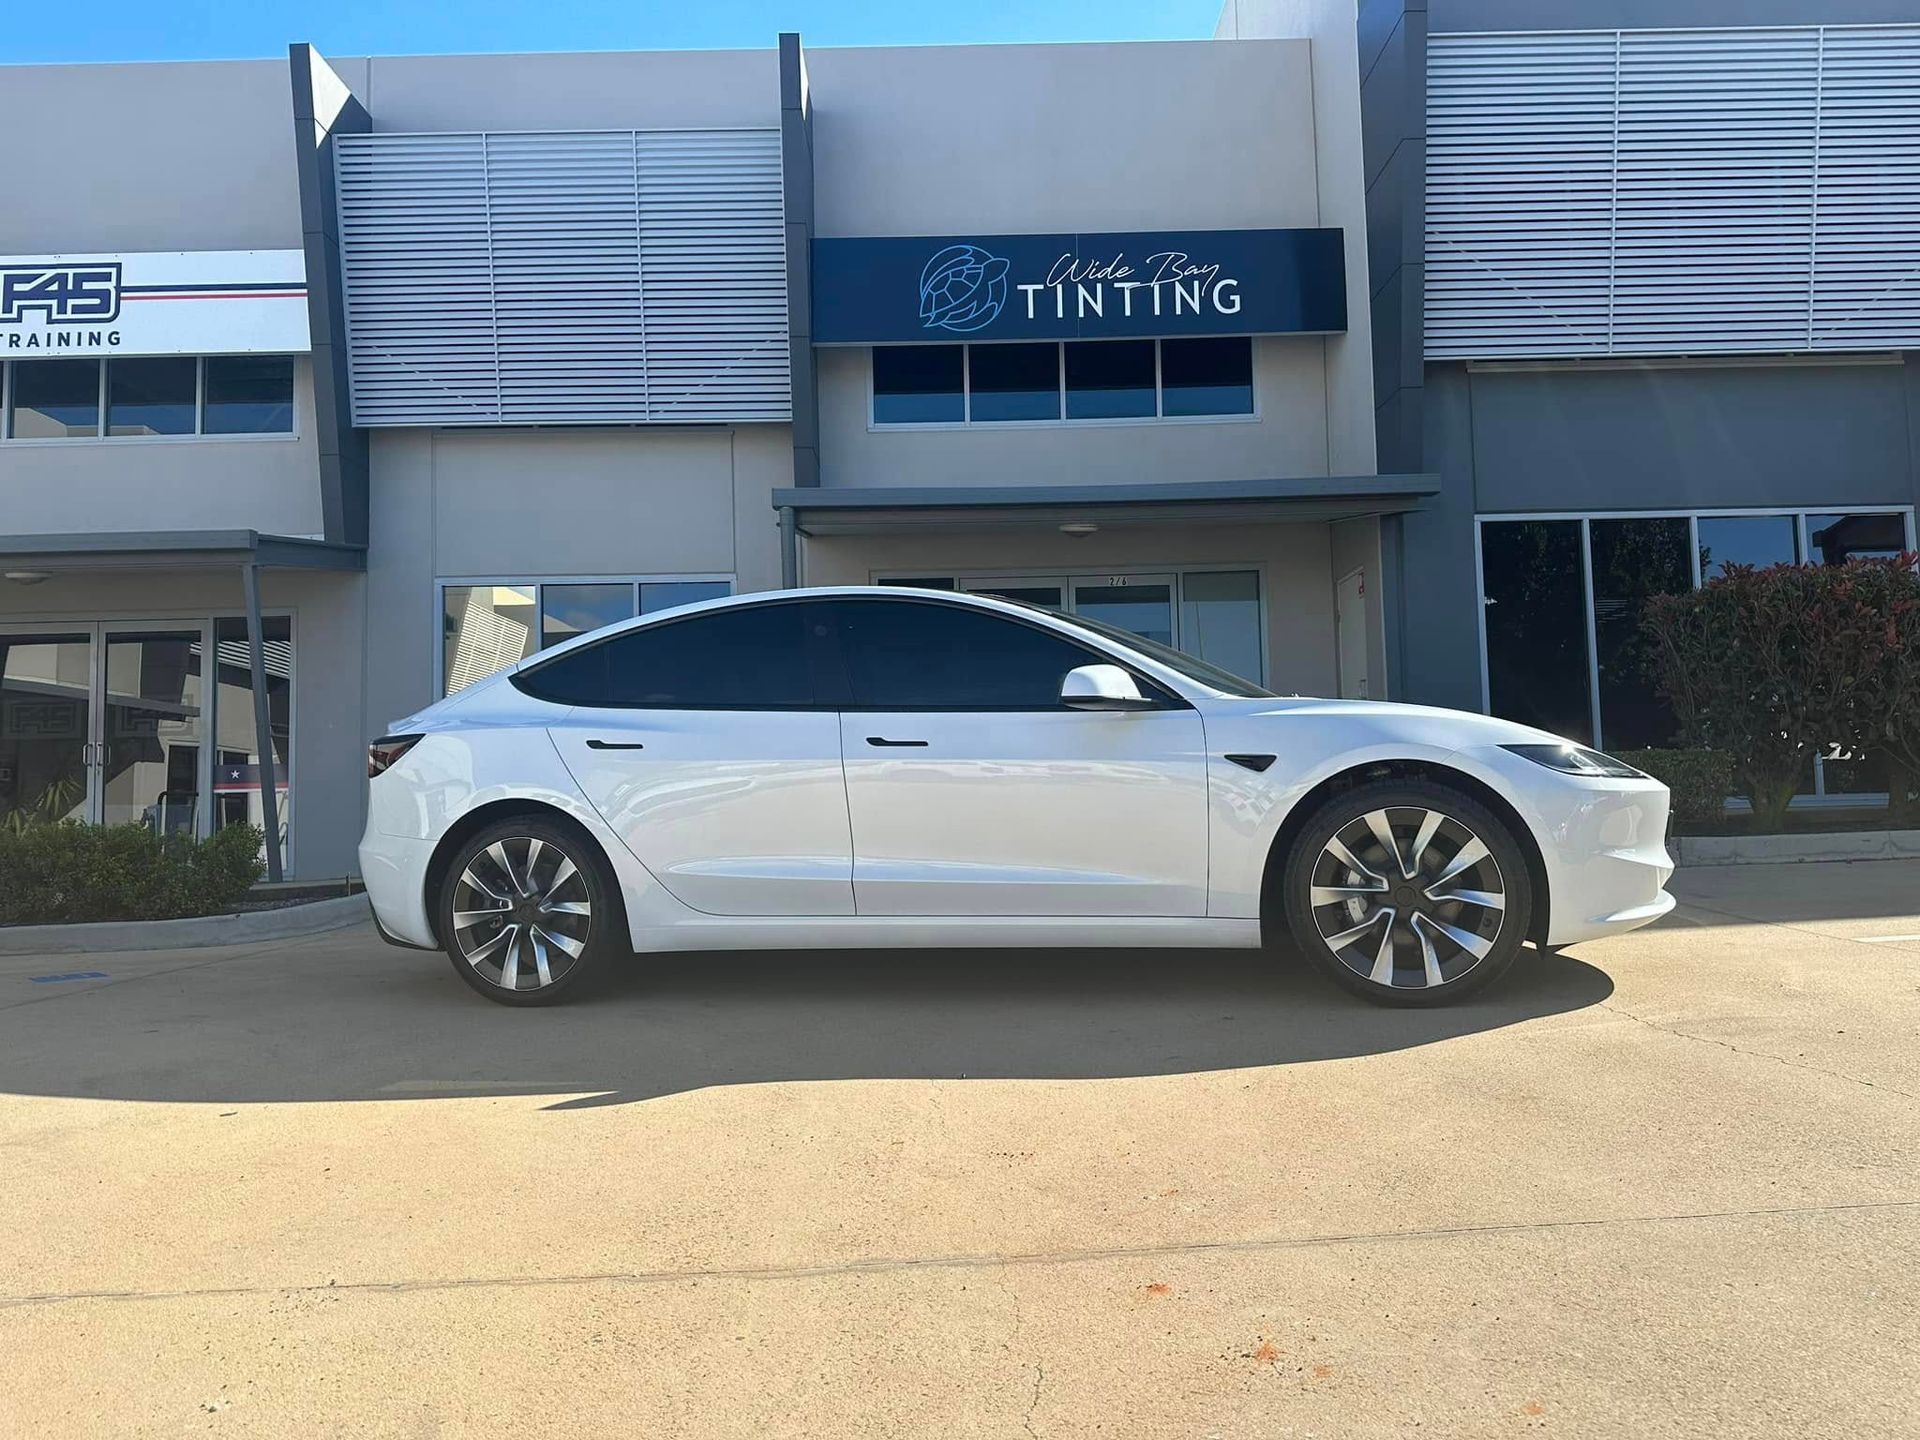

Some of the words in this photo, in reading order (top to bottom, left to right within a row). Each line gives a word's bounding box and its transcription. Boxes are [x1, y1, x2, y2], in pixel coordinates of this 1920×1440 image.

[2, 271, 112, 315] F45
[1046, 252, 1135, 287] Wide
[1128, 251, 1220, 296] Bay
[1017, 279, 1241, 319] TINTING
[1109, 576, 1127, 586] 2/6
